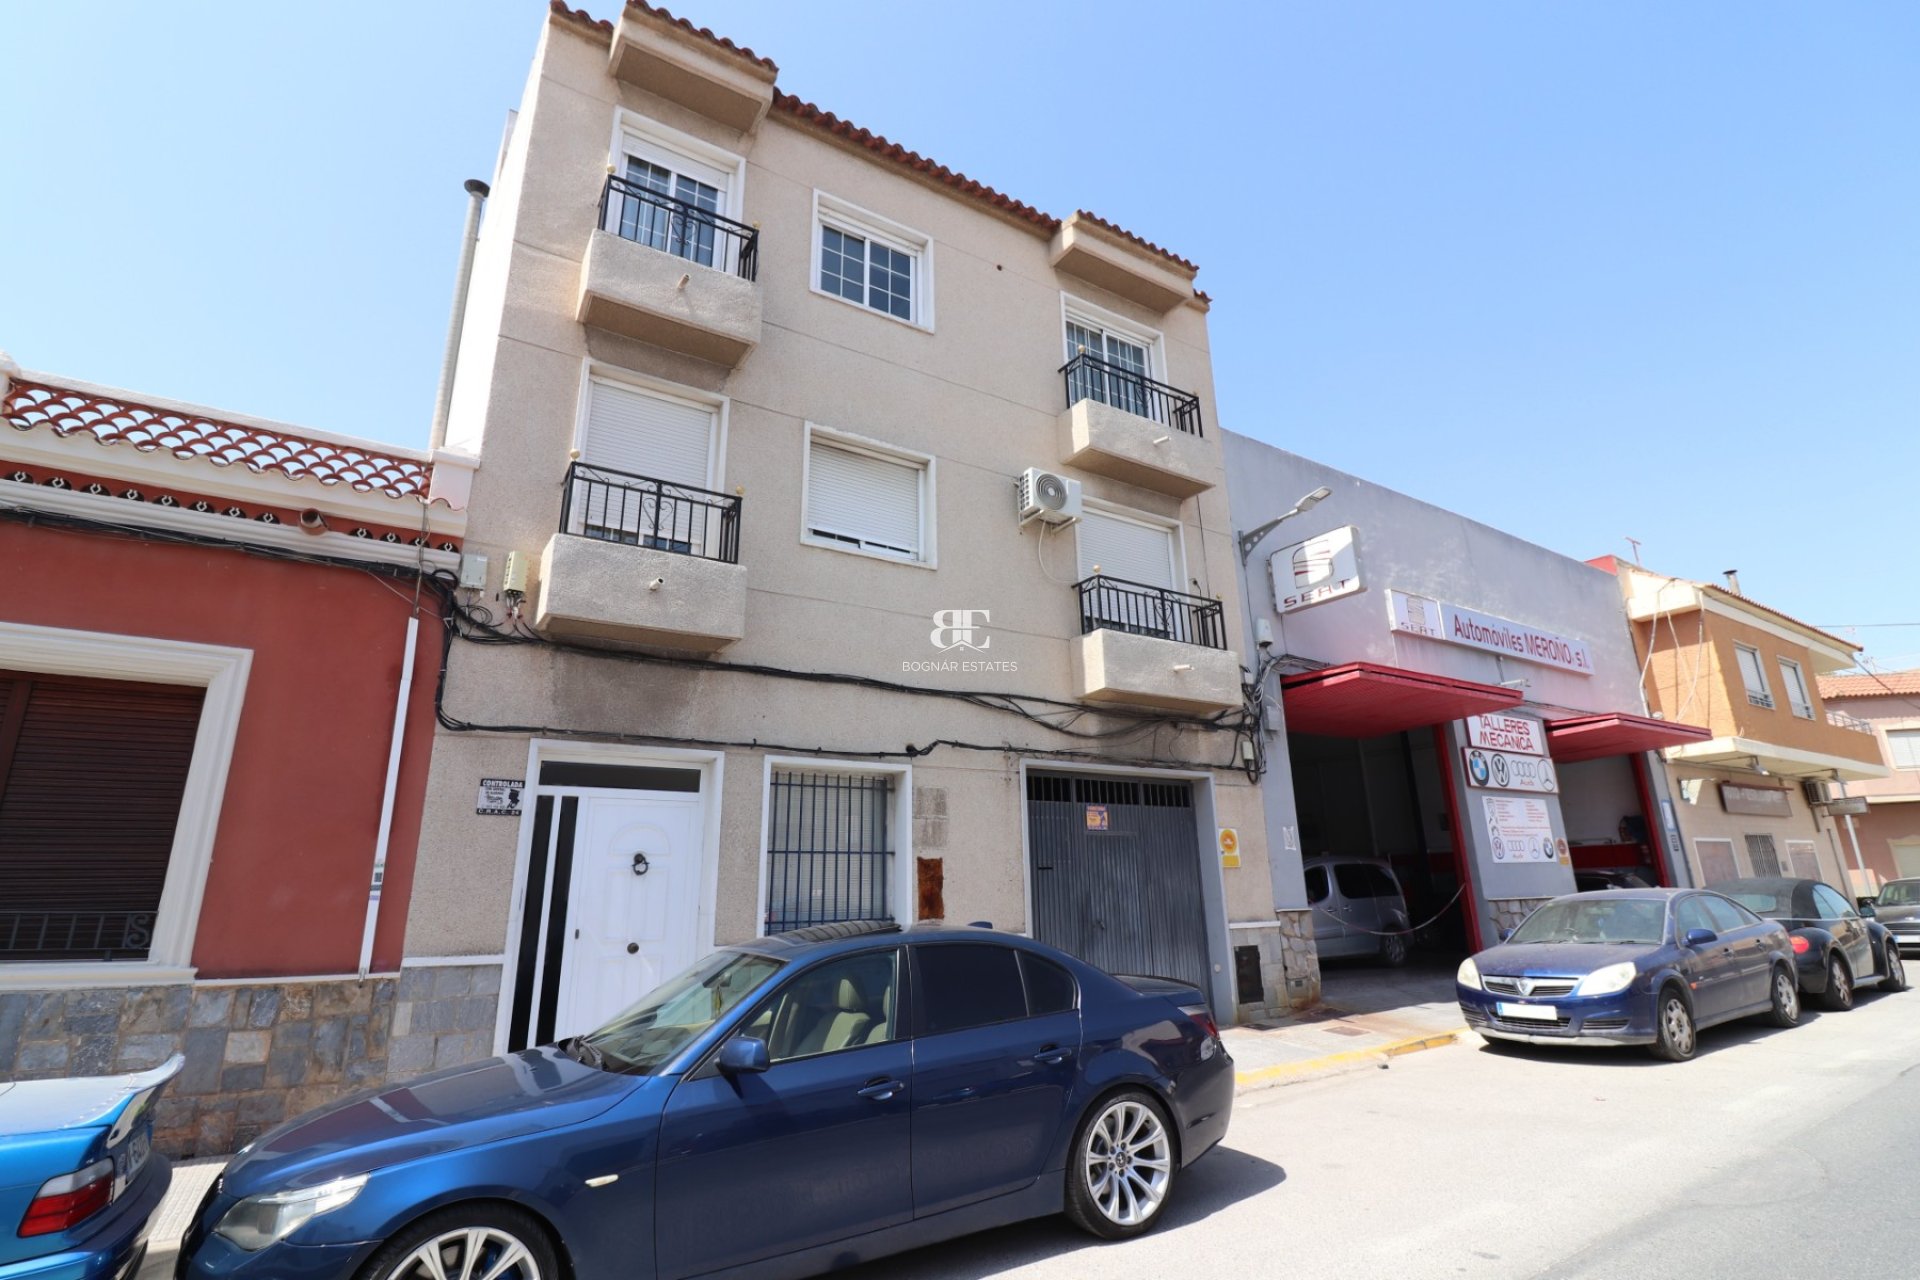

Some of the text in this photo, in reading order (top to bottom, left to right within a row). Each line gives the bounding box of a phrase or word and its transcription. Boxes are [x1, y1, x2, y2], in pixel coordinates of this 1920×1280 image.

[1283, 578, 1350, 608] SEAT
[1400, 621, 1437, 636] SEAT
[1454, 614, 1524, 653] Automóviles
[1479, 715, 1530, 736] TALLERES
[1479, 731, 1534, 751] MECANICA
